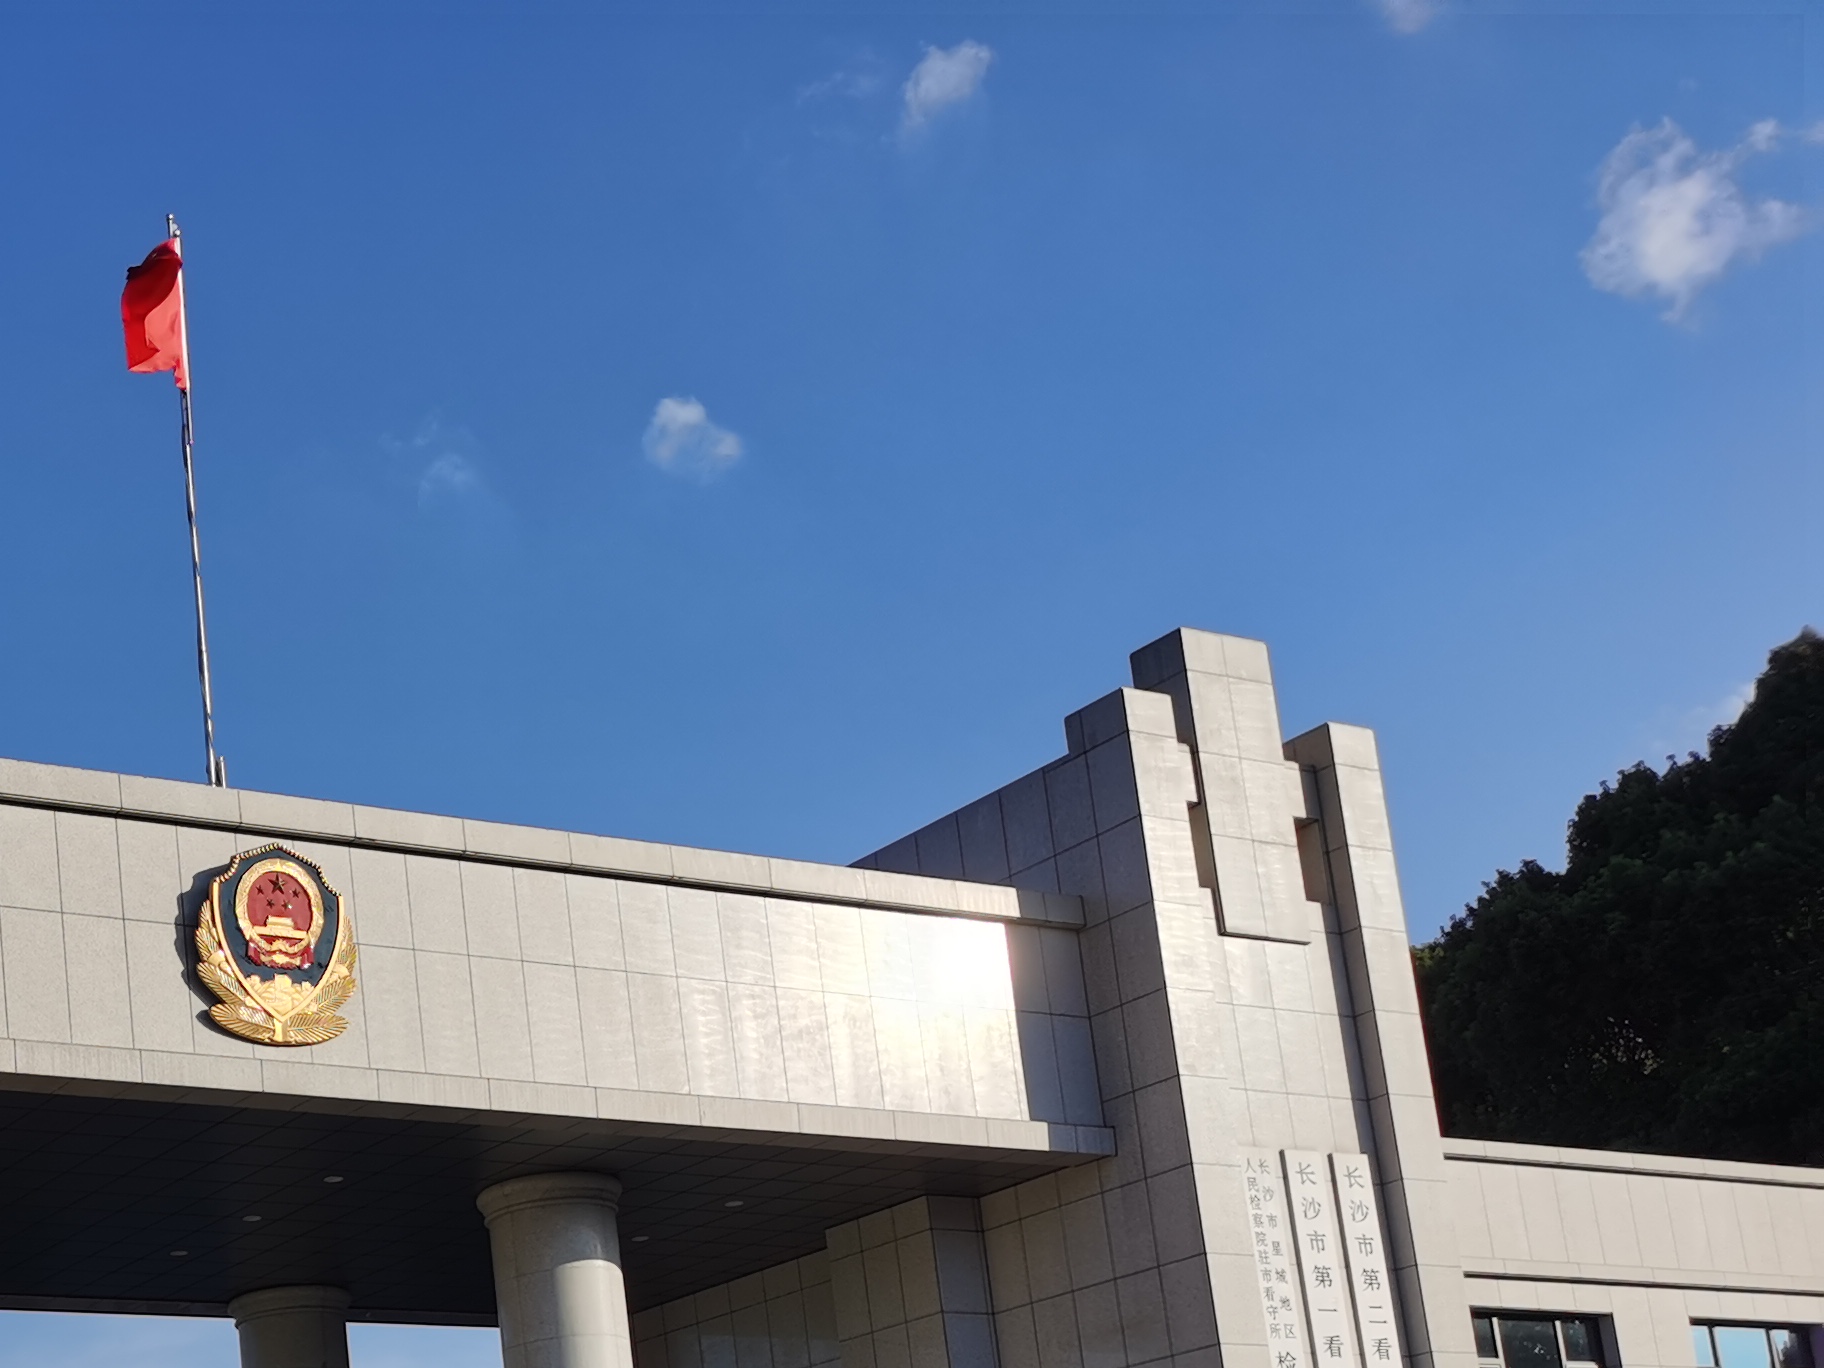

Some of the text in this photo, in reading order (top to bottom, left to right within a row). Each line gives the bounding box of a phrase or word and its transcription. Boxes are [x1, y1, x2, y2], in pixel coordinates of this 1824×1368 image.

[1244, 1157, 1282, 1341] 人民检察院驻市看守所
[1258, 1158, 1297, 1340] 长沙市星城地区
